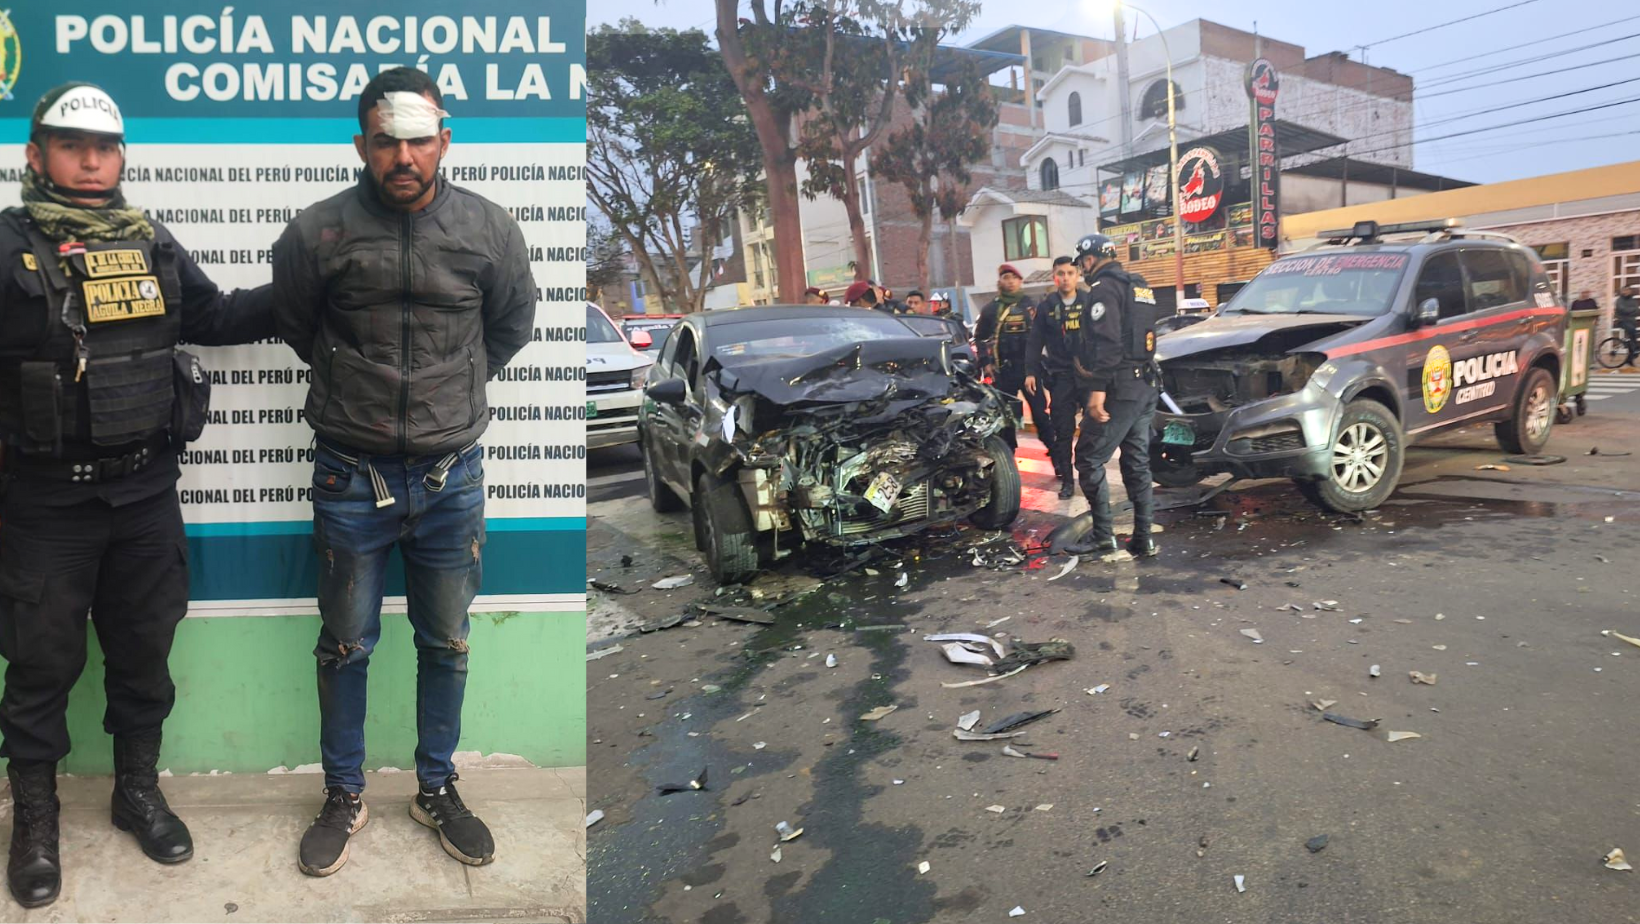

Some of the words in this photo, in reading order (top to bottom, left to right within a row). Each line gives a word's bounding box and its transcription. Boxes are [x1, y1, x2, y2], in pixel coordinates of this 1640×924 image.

[55, 7, 275, 53] POLICÍA
[291, 15, 567, 54] NACIONAL
[165, 55, 469, 101] COMISAA
[486, 63, 552, 100] LA
[155, 167, 224, 182] NACIONAL
[228, 167, 251, 182] DEL
[256, 164, 291, 182] PERÚ
[296, 165, 349, 182] POLICÍA
[452, 164, 487, 181] PERÚ
[491, 163, 545, 181] POLICÍA
[1258, 108, 1276, 239] PARRILLAS
[156, 209, 225, 223] NACIONAL
[229, 208, 252, 223] DEL
[256, 206, 291, 223] PERÚ
[1180, 195, 1216, 215] RODEO
[230, 250, 253, 264] DEL
[1264, 258, 1316, 276] SECCION
[1315, 256, 1336, 270] DE
[1336, 255, 1407, 269] EMERGENCIA
[89, 280, 141, 305] POLICIA
[92, 302, 129, 318] AGUILA
[131, 299, 161, 314] NEGRA
[231, 370, 255, 385] DEL
[258, 367, 293, 384] PERÚ
[497, 364, 542, 382] OLICÍA
[545, 366, 586, 381] NACIO
[1453, 350, 1519, 388] POLICIA
[232, 410, 255, 425] DEL
[258, 406, 293, 424] PERÚ
[489, 404, 541, 421] POLICÍA
[544, 406, 586, 421] NACIO
[179, 449, 229, 465] CIONAL
[232, 449, 255, 464] DEL
[259, 446, 293, 463] PERÚ
[488, 443, 541, 460] POLICÍA
[544, 445, 586, 460] NACIO
[180, 488, 229, 504] CIONAL
[233, 488, 256, 503] DEL
[259, 485, 294, 502] PERÚ
[488, 482, 541, 499] POLICÍA
[544, 483, 585, 498] NACIO
